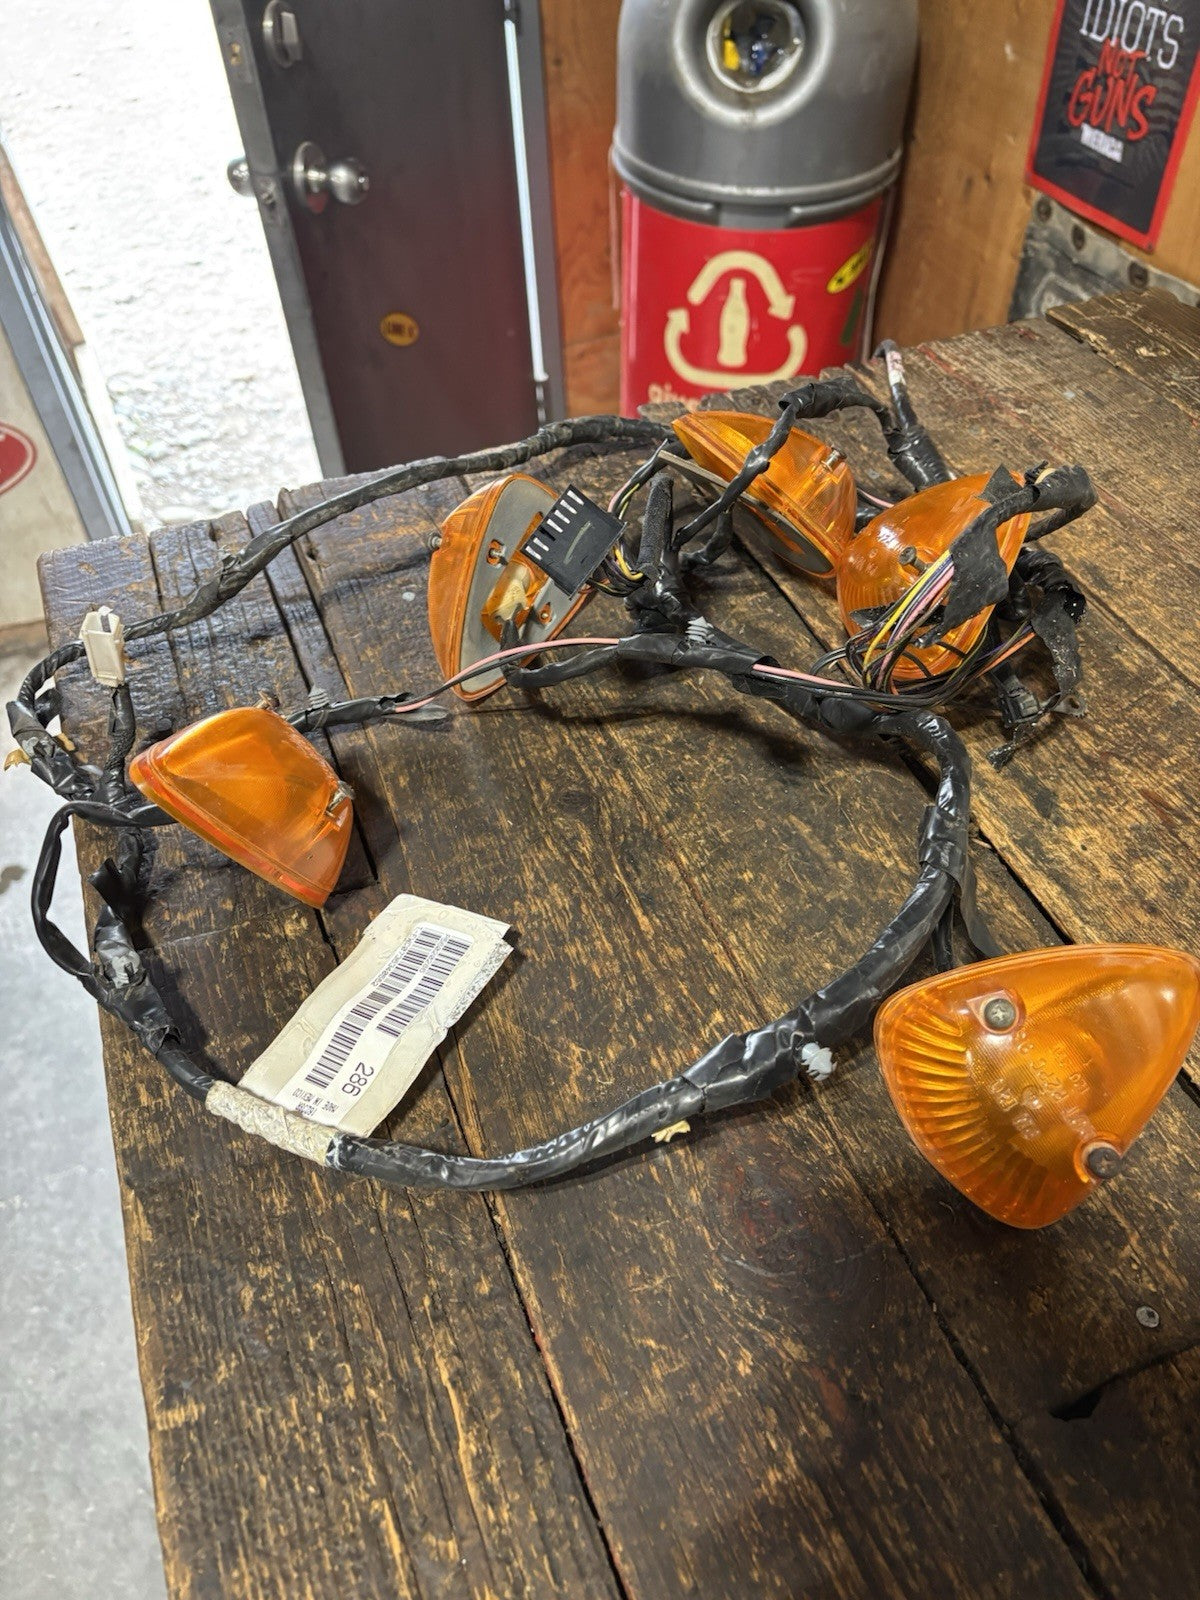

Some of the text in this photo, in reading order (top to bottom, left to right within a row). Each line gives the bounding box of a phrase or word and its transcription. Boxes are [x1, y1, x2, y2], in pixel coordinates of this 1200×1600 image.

[1079, 0, 1184, 70] IDIOTS
[1097, 37, 1147, 80] NOT
[1067, 66, 1157, 141] GUNS
[341, 1061, 375, 1097] 286
